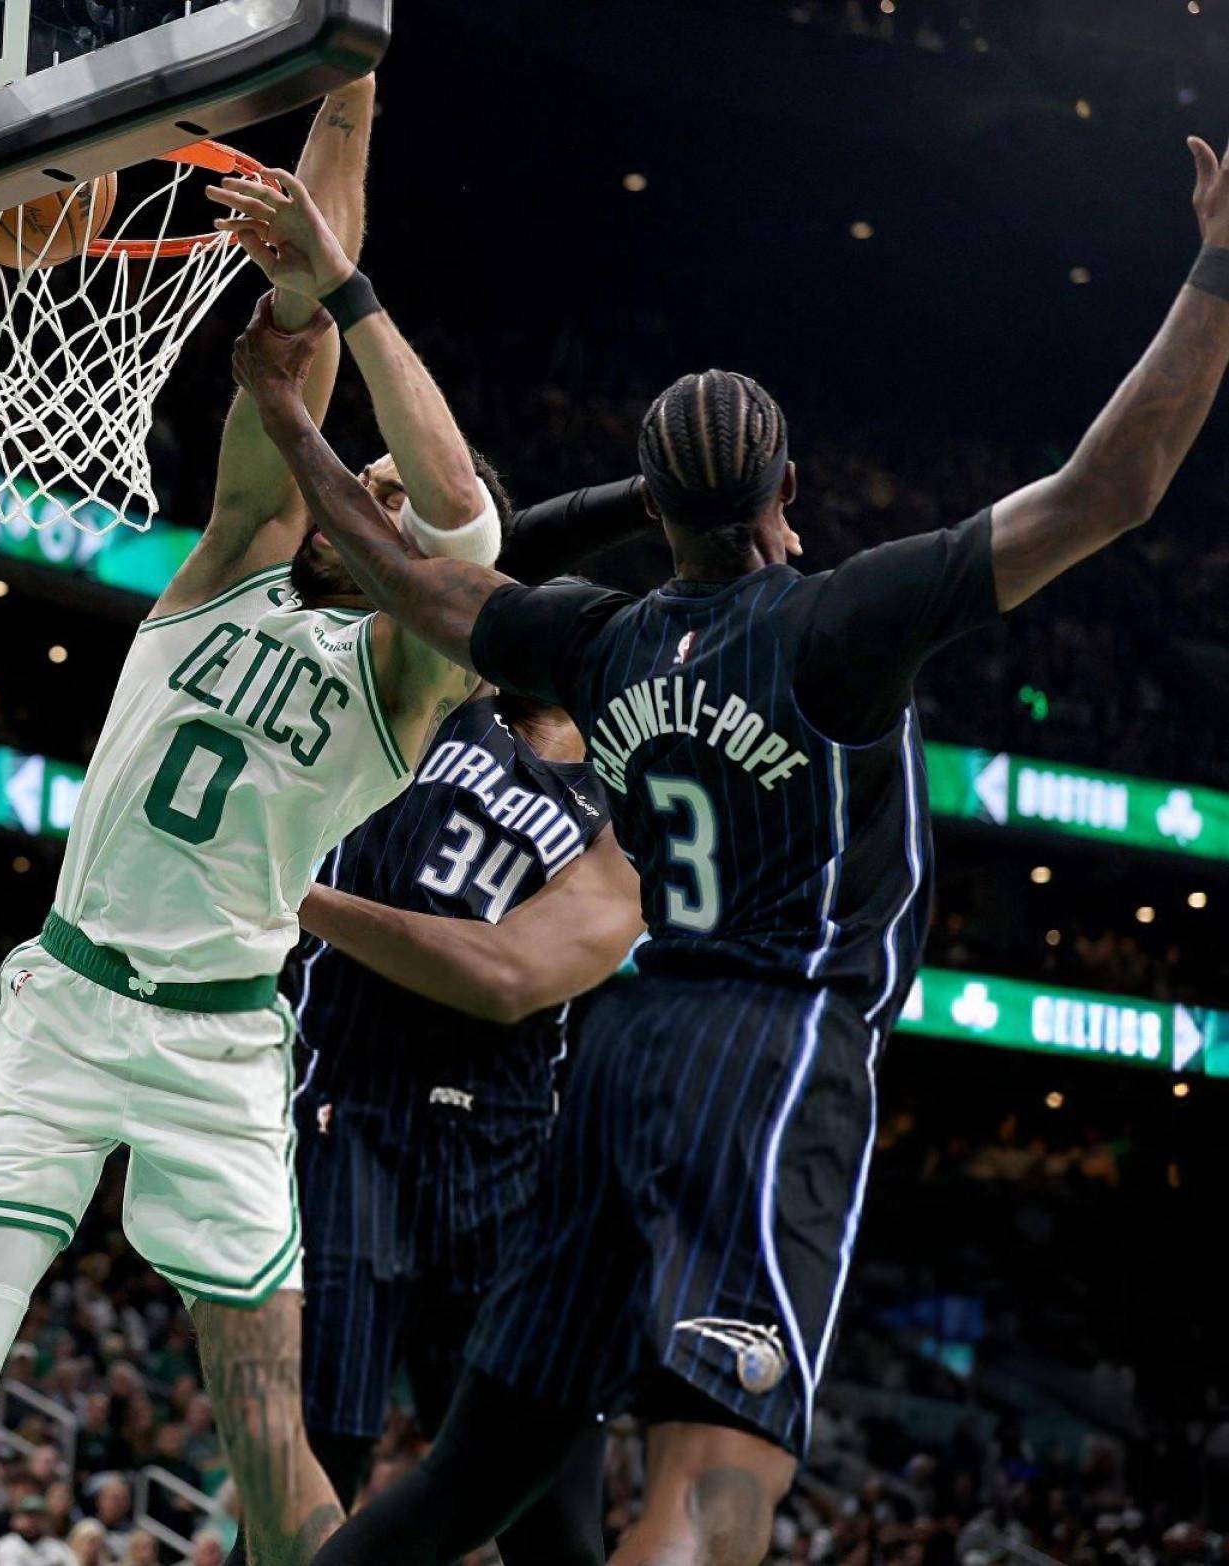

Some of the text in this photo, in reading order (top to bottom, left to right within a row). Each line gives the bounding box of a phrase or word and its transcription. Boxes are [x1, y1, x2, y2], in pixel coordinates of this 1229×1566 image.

[143, 718, 249, 845] 0
[590, 675, 810, 795] CALDWELL-POPE
[645, 772, 721, 933] 3
[1016, 767, 1128, 832] BOSTON
[417, 809, 534, 925] 34
[1031, 996, 1161, 1060] CELTICS
